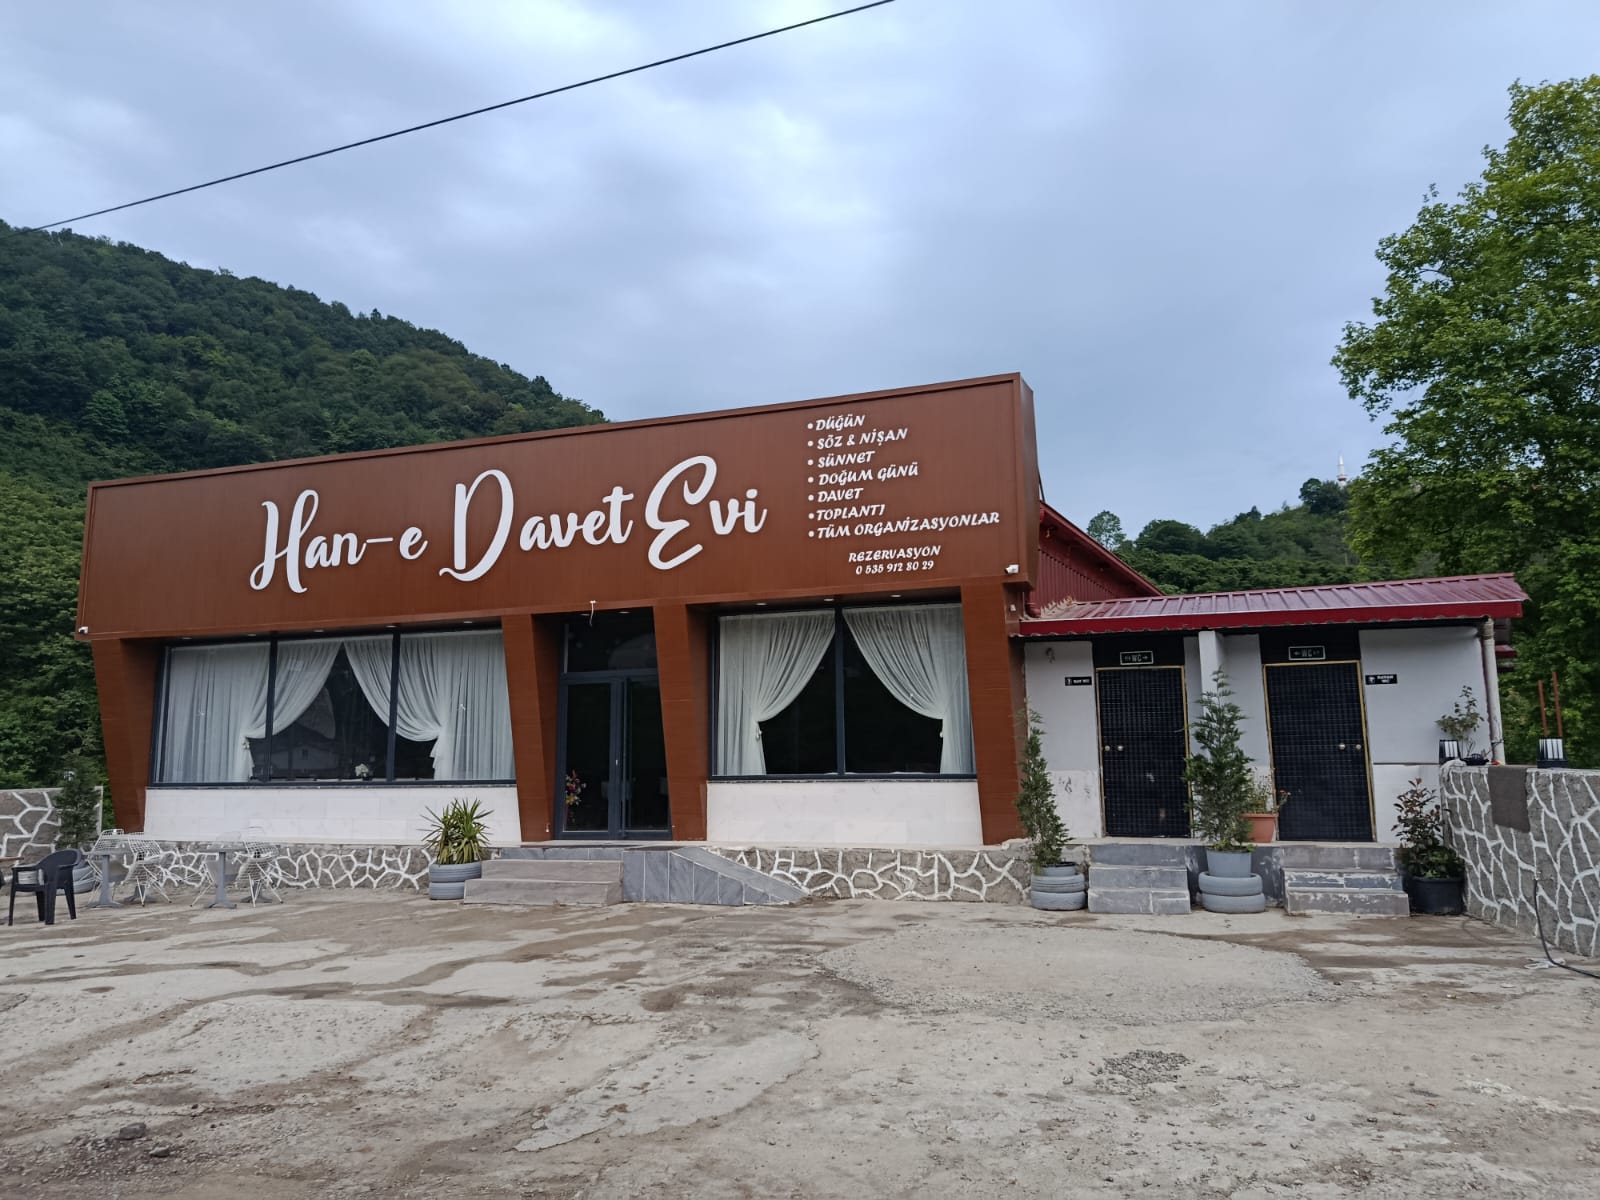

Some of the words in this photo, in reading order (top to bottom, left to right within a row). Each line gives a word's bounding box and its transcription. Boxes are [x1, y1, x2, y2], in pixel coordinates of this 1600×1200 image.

[815, 413, 866, 432] DÜĞÜN
[817, 434, 844, 450] SÖZ
[846, 433, 856, 447] &
[858, 428, 909, 447] NİŞAN
[817, 450, 876, 469] SÜNNET
[818, 469, 874, 486] DOĞUM
[876, 462, 919, 481] GÜNÜ
[817, 487, 865, 503] DAVET
[816, 504, 886, 521] TOPLANTI
[249, 489, 428, 594] Han-e
[438, 468, 635, 582] Davet
[644, 455, 768, 570] Evi
[817, 523, 850, 539] TÜM
[854, 511, 1000, 537] ORGANİZASYONLAR
[848, 545, 942, 563] REZERVASYON
[855, 565, 863, 575] 0
[886, 562, 904, 573] 912
[906, 561, 920, 572] 80
[921, 560, 935, 570] 29
